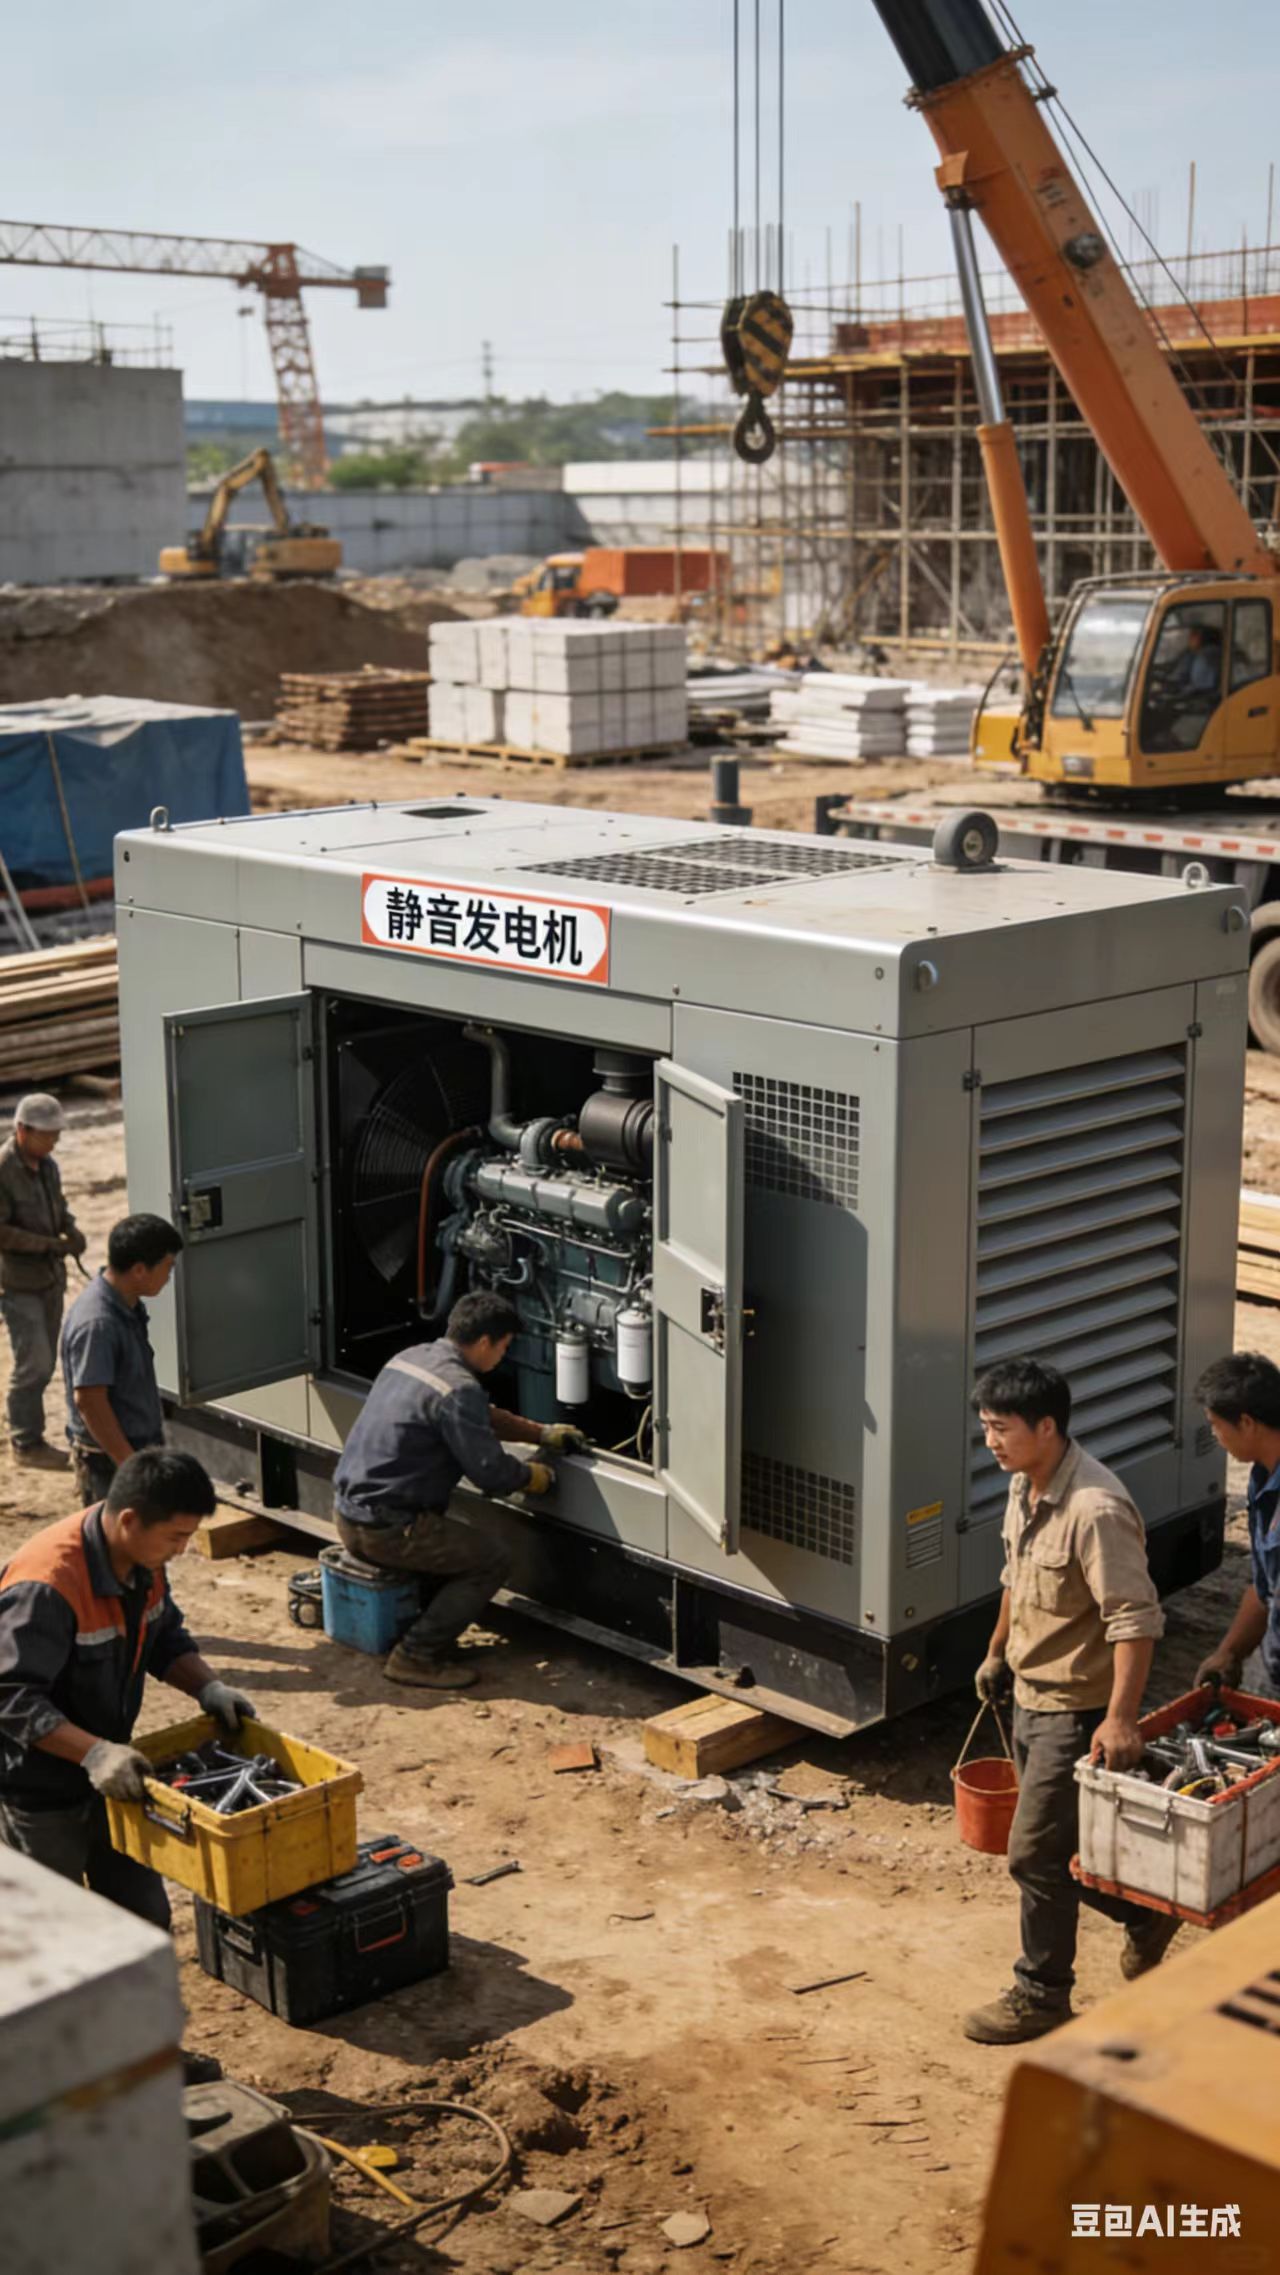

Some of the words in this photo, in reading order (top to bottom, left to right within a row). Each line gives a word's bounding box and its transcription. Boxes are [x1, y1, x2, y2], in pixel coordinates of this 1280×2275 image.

[385, 886, 583, 967] 静音发电机
